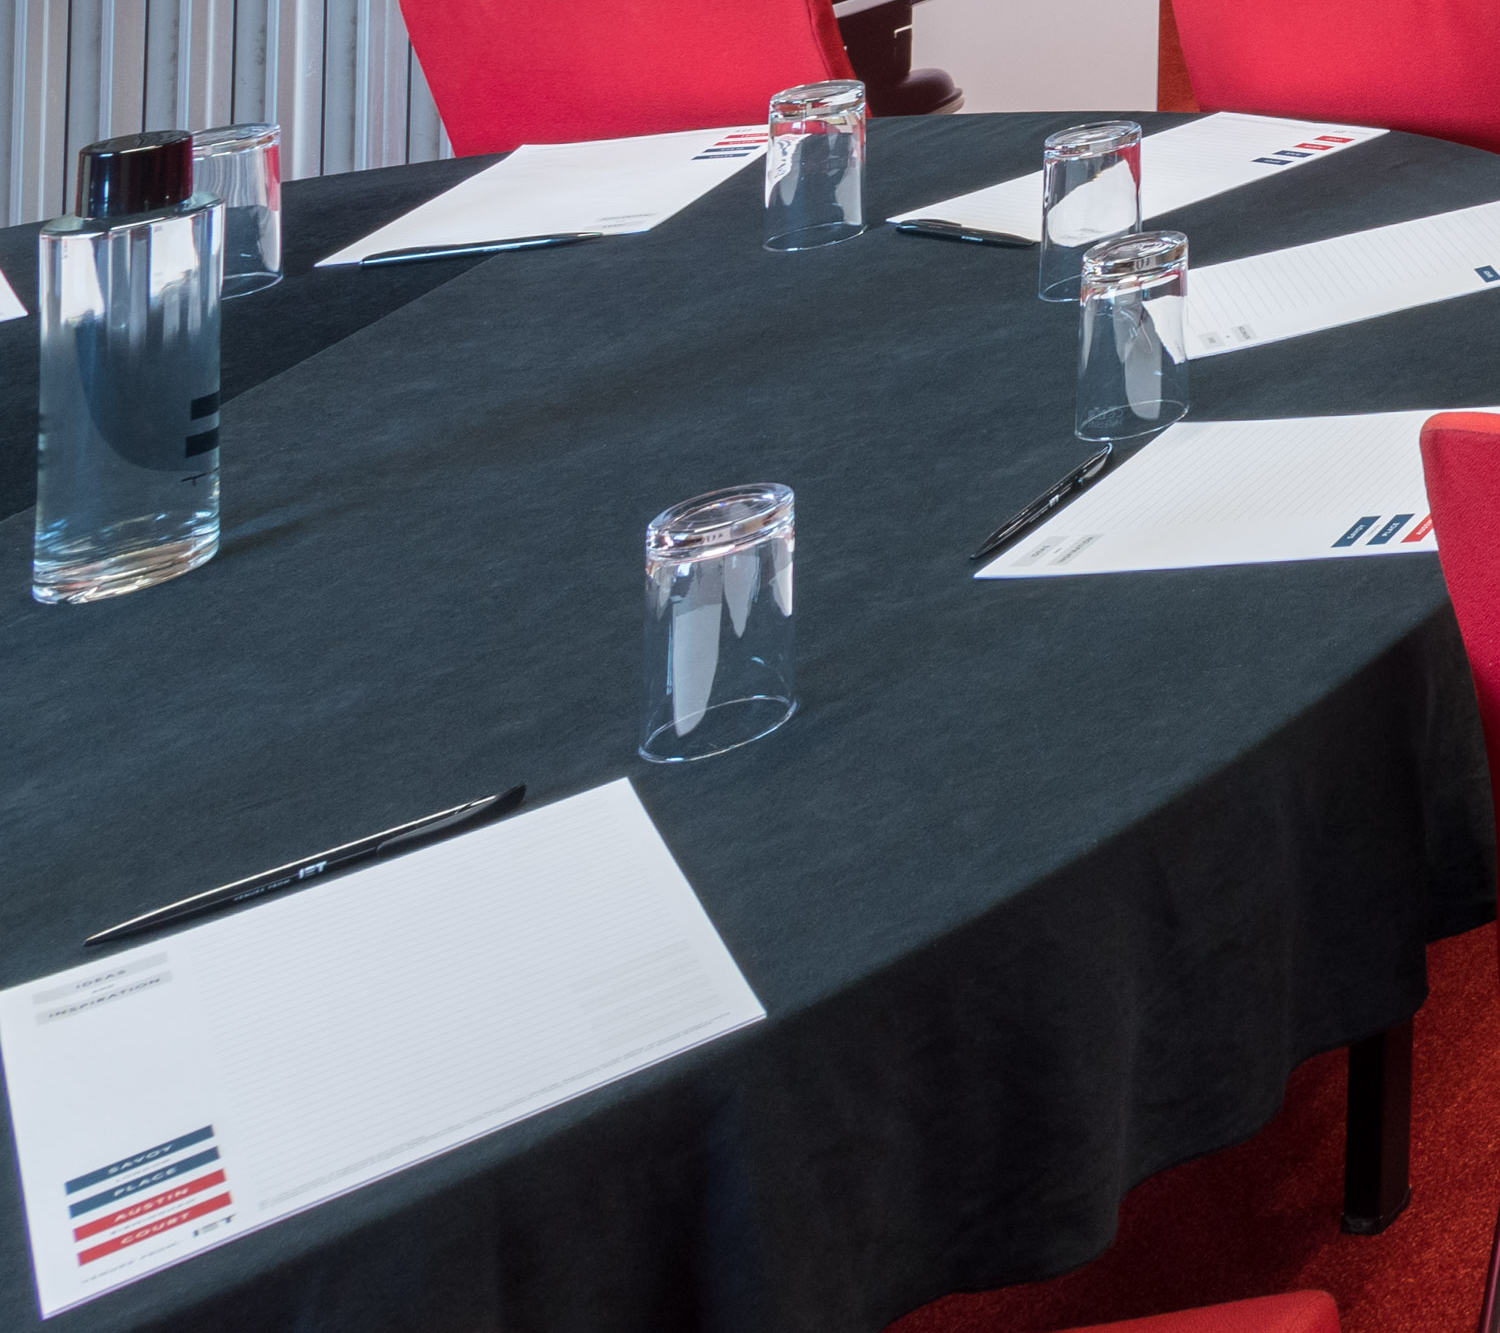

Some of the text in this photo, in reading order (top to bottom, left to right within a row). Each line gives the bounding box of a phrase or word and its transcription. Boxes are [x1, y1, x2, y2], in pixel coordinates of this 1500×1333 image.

[298, 860, 328, 880] IET
[75, 968, 127, 990] IDEAS
[49, 977, 161, 1019] INSPIRATION
[107, 1144, 174, 1176] SAVOY
[113, 1166, 178, 1198] PLACE
[112, 1186, 190, 1223] AUSTIN
[119, 1211, 192, 1245] COURT
